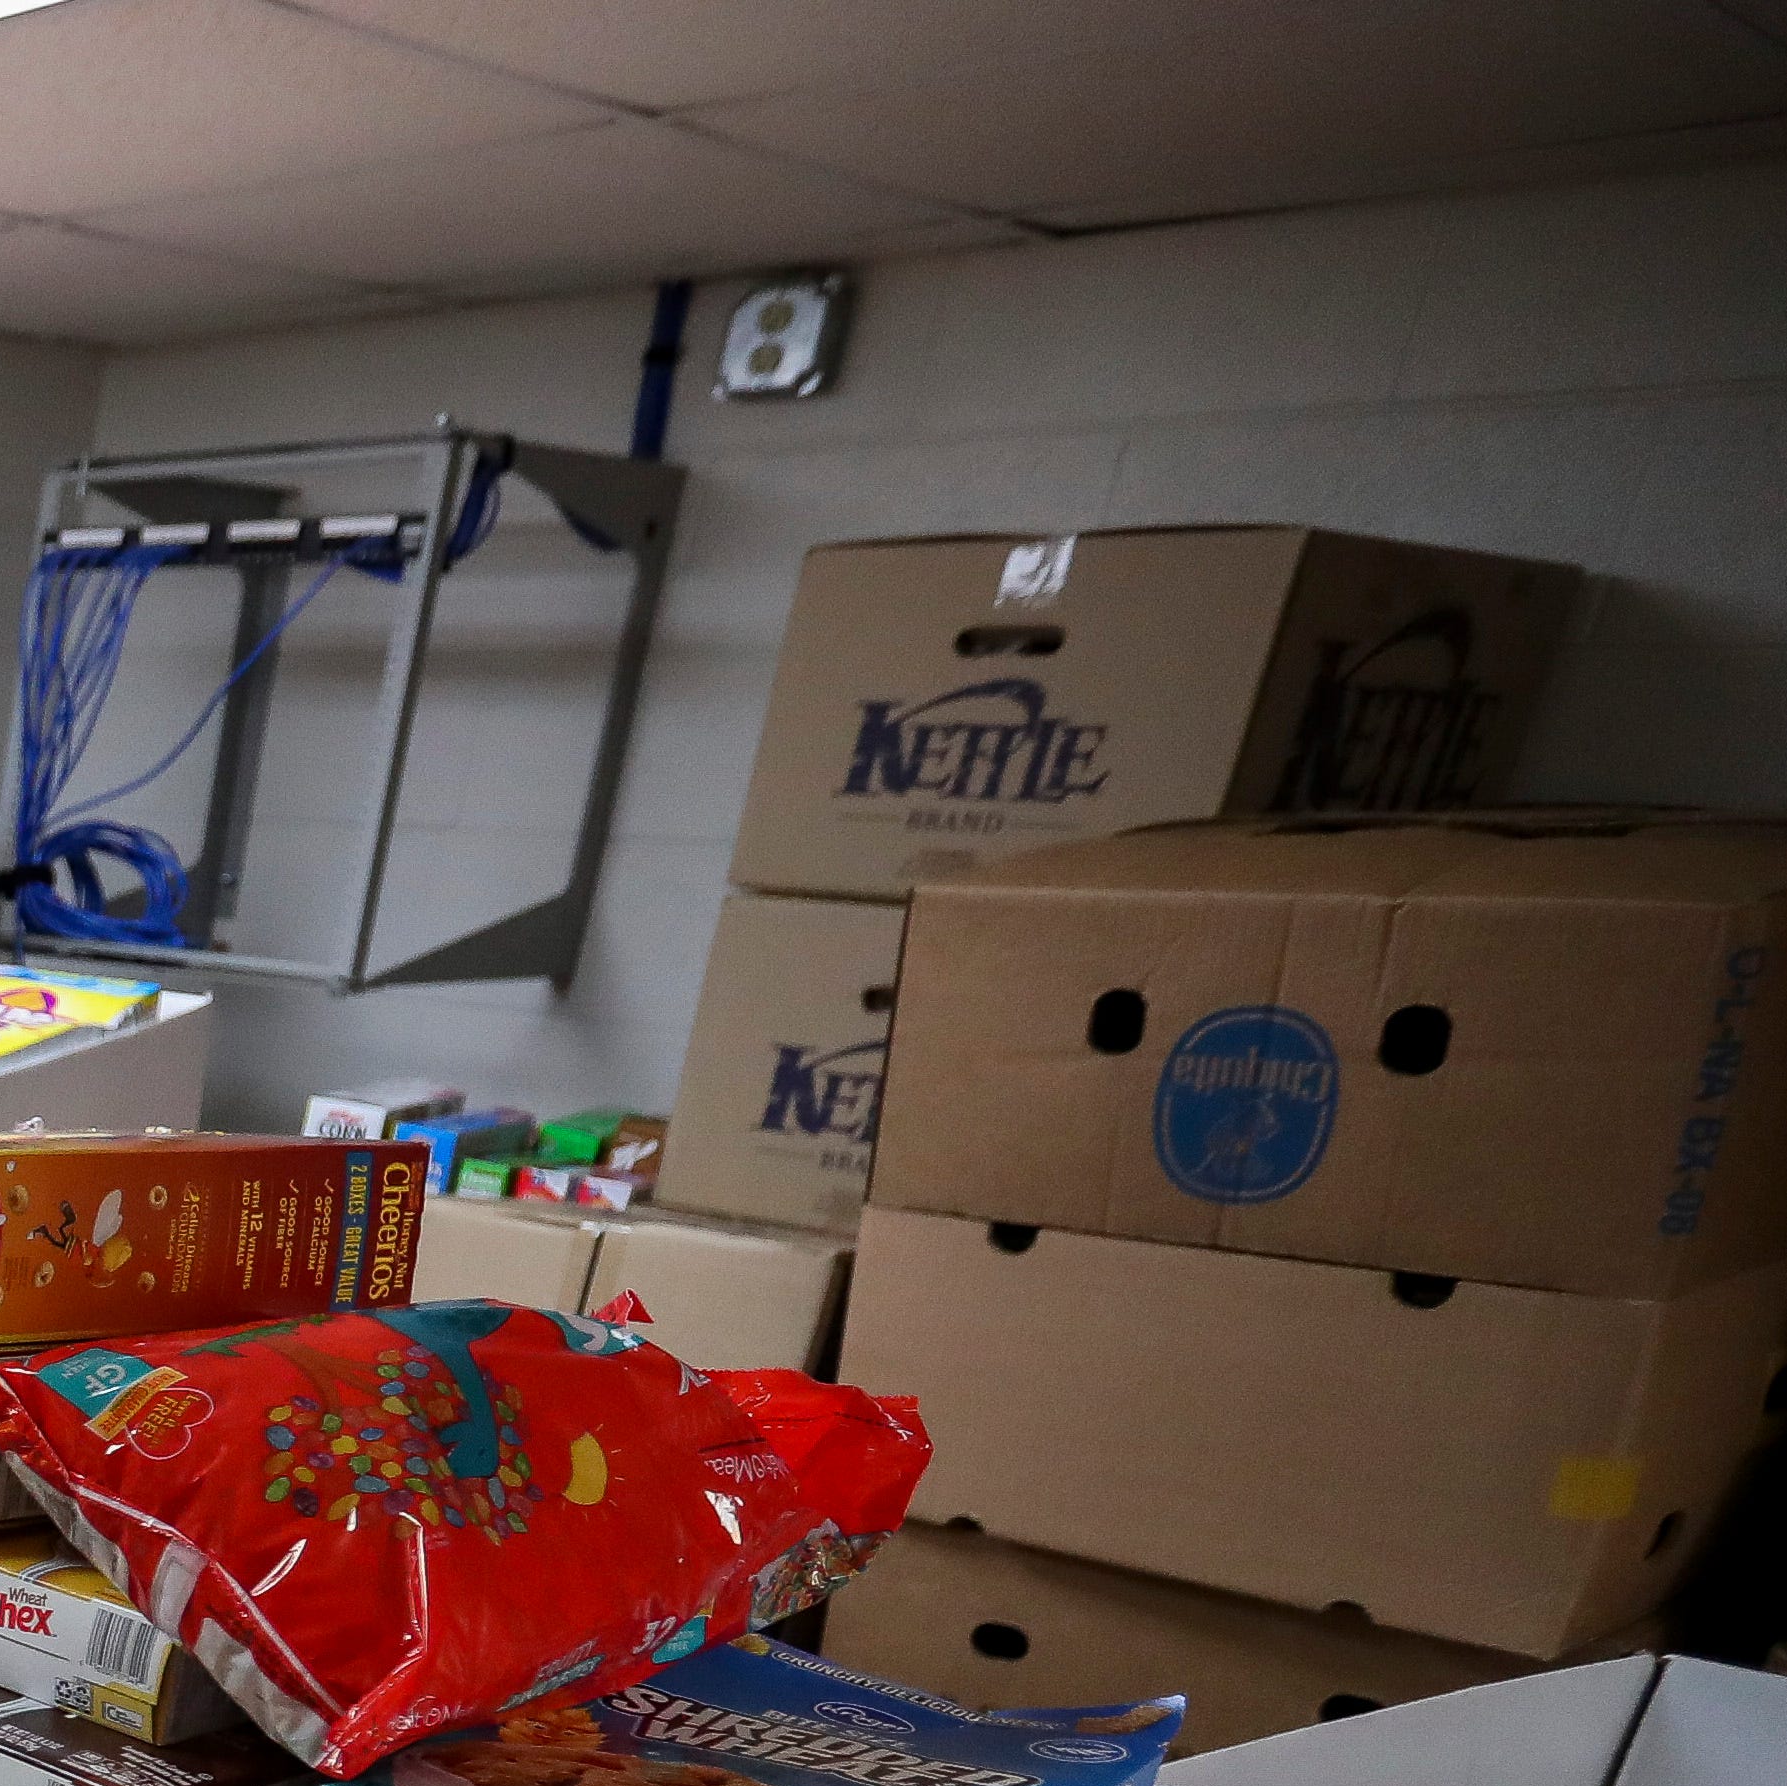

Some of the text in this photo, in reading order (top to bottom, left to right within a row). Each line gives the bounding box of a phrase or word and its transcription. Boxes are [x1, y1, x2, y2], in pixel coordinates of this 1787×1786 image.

[906, 808, 1004, 834] BRAND
[335, 1176, 367, 1305] BOXES GREAT VALUE
[369, 1161, 411, 1300] Cheerios
[398, 1210, 416, 1252] Honey
[9, 1586, 49, 1609] Wheat
[611, 1686, 1029, 1786] SHREDDED
[647, 1721, 921, 1786] WHEAT
